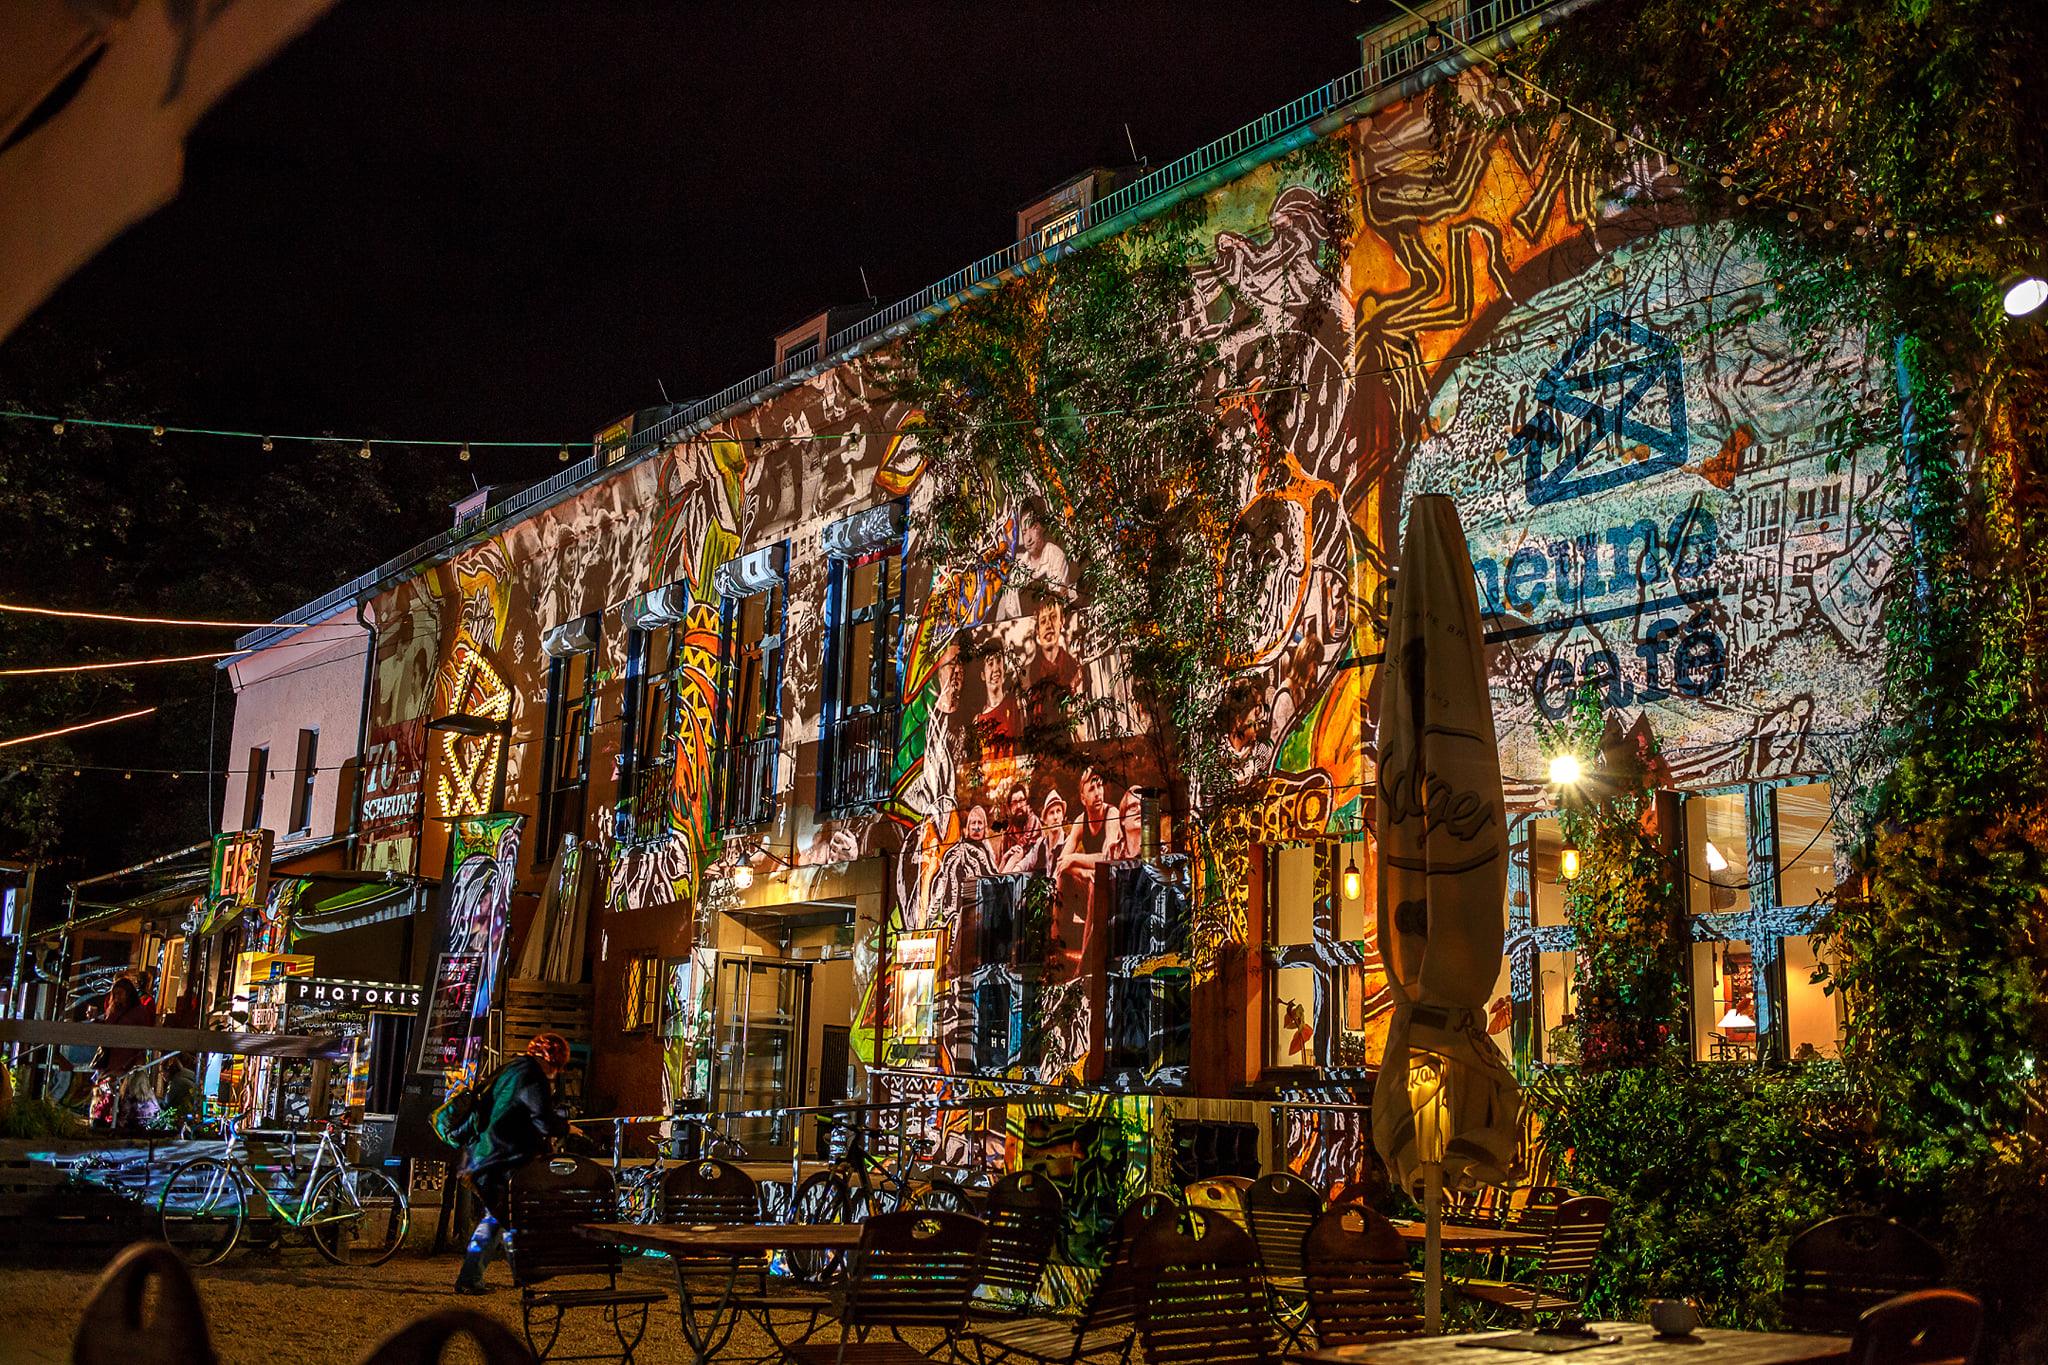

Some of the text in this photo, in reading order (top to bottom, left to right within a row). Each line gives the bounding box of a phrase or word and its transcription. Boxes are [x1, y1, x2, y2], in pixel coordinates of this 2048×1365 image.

[1535, 608, 1726, 720] café
[367, 740, 398, 793] 70
[362, 791, 418, 822] SCHEUNE
[220, 841, 253, 897] EIS
